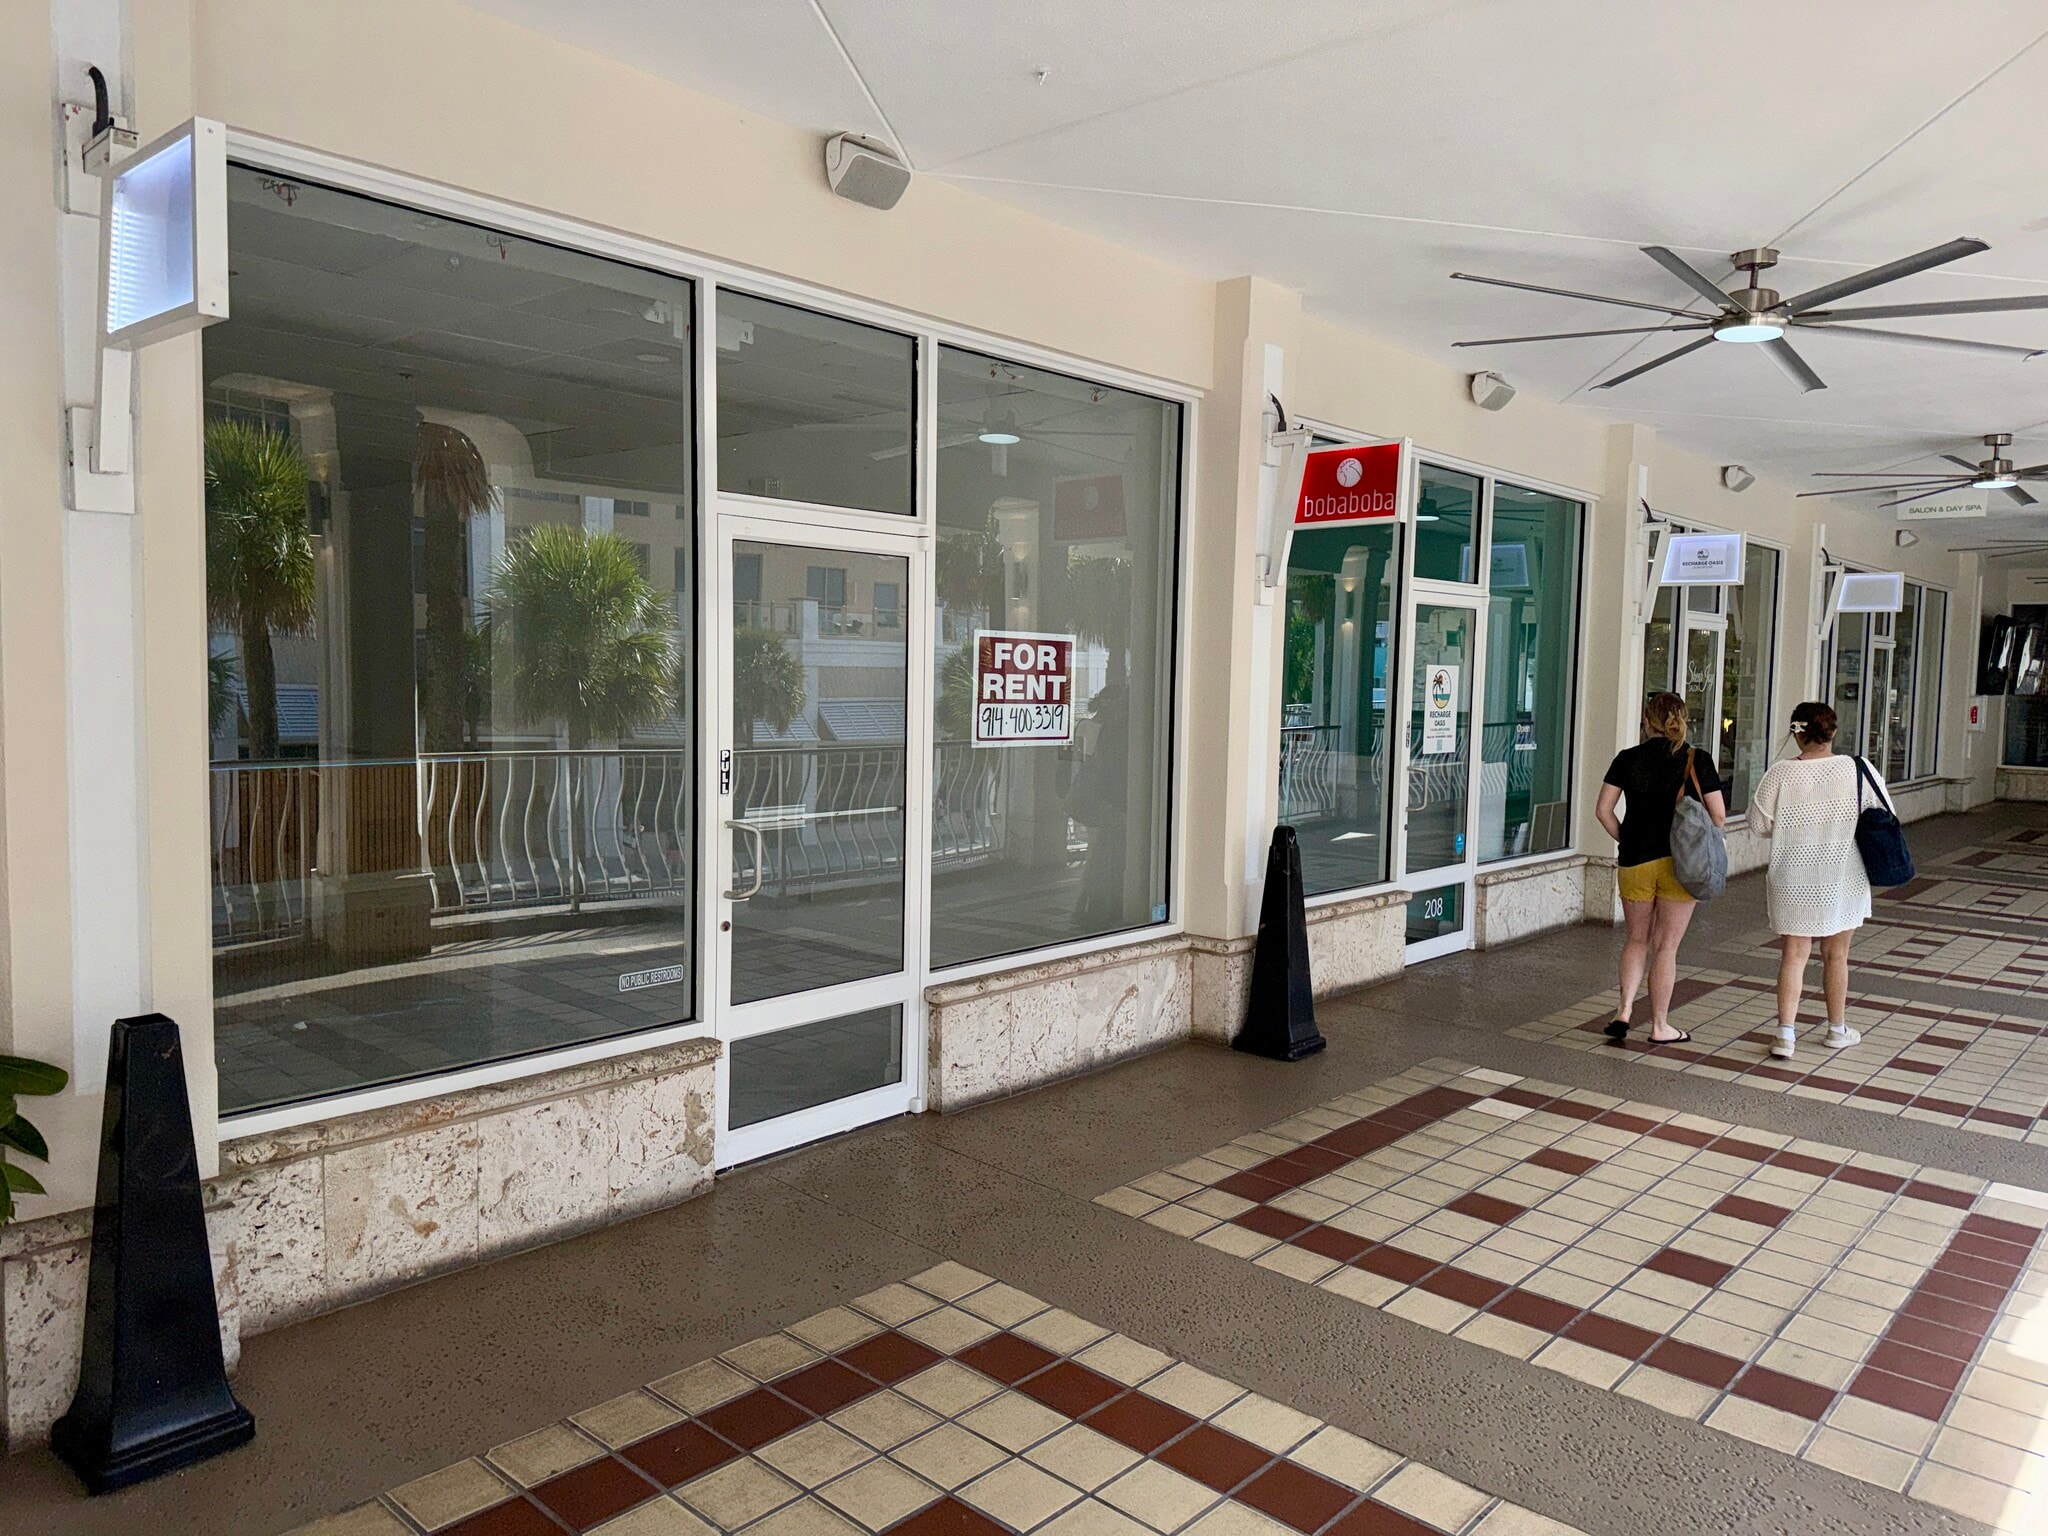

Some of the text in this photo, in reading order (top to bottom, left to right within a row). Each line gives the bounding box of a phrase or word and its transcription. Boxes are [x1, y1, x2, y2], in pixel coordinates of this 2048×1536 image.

[1304, 489, 1394, 517] bobaboba
[994, 642, 1057, 671] FOR
[982, 673, 1067, 700] RENT
[1429, 710, 1451, 718] RECHARGE
[721, 750, 730, 794] PULL
[1424, 897, 1443, 919] 208
[621, 967, 681, 988] NO PUBLIC RESTROOMS
